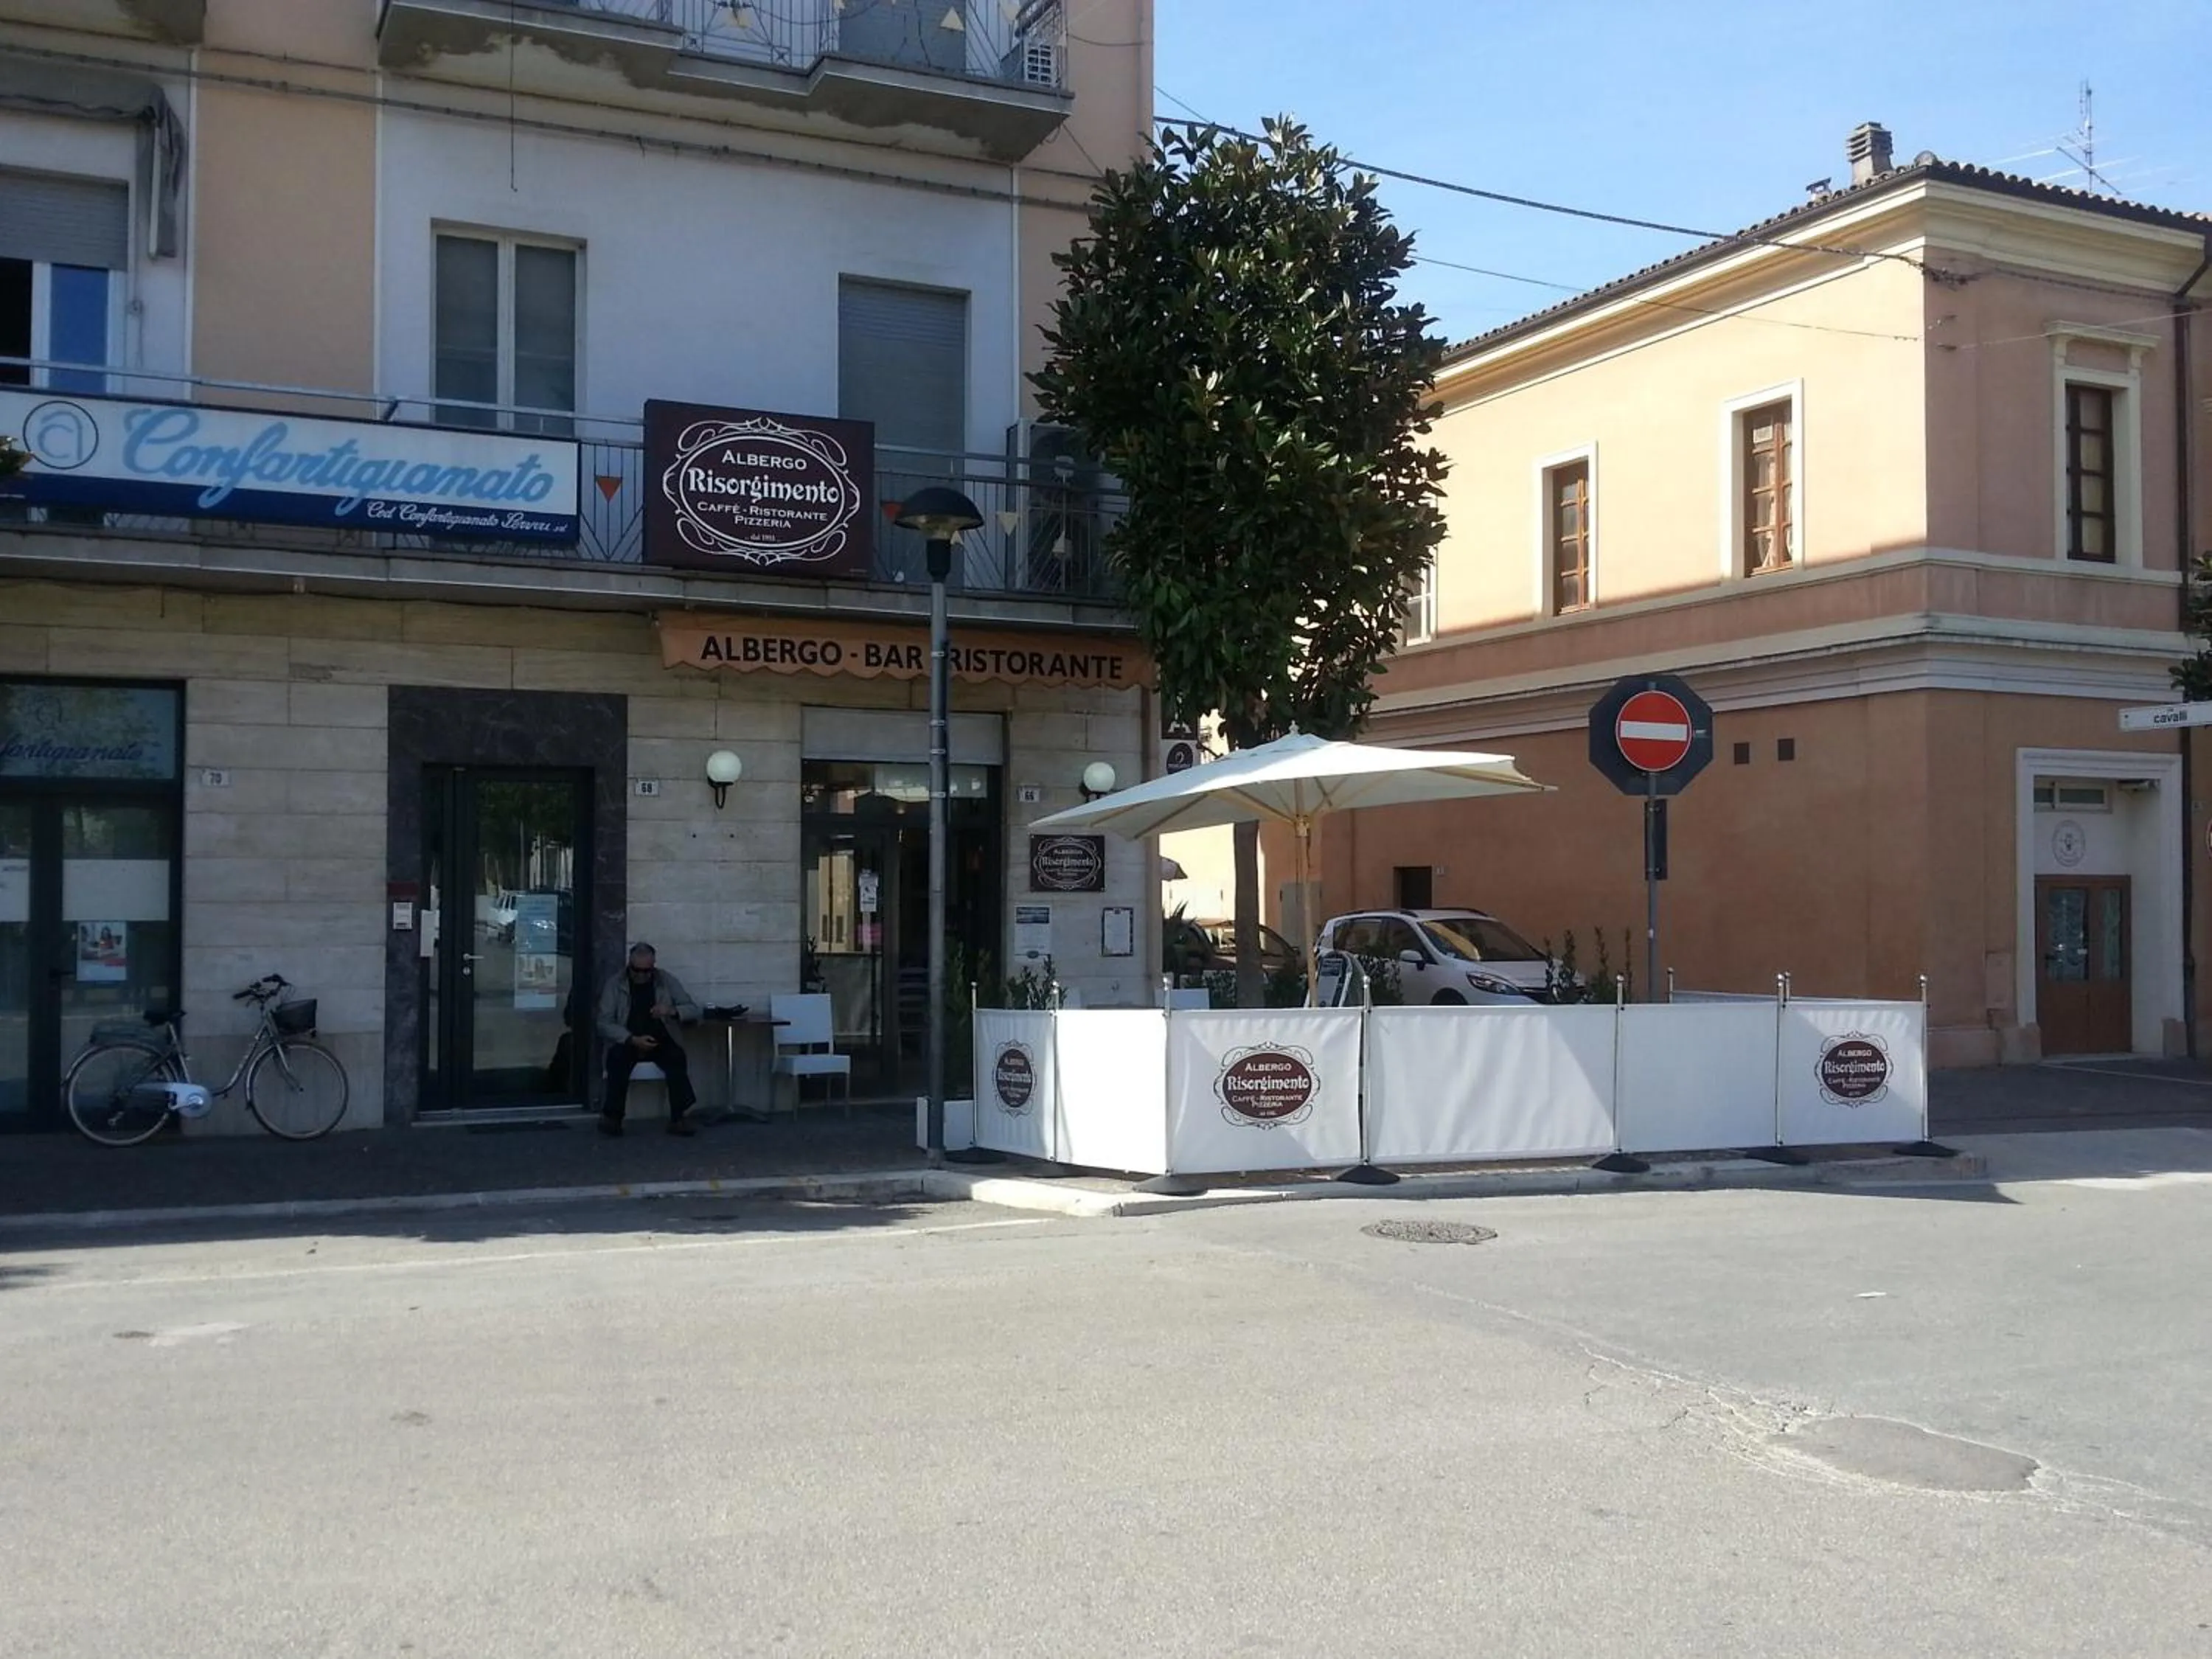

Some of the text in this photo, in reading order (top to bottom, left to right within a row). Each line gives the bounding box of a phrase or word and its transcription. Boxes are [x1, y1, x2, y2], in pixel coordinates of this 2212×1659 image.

[721, 450, 808, 470] ALBERGO
[687, 467, 840, 504] Risorgimento
[749, 505, 828, 521] RISTORANTE
[734, 515, 792, 529] PIZZERIA
[700, 635, 842, 666] ALBERGO
[865, 642, 924, 670] BAR
[950, 648, 1123, 680] RISTORANTE
[1244, 1062, 1293, 1071] ALBERGO
[1824, 1060, 1885, 1075] Risorgimento
[1226, 1075, 1310, 1093] Risorgimento
